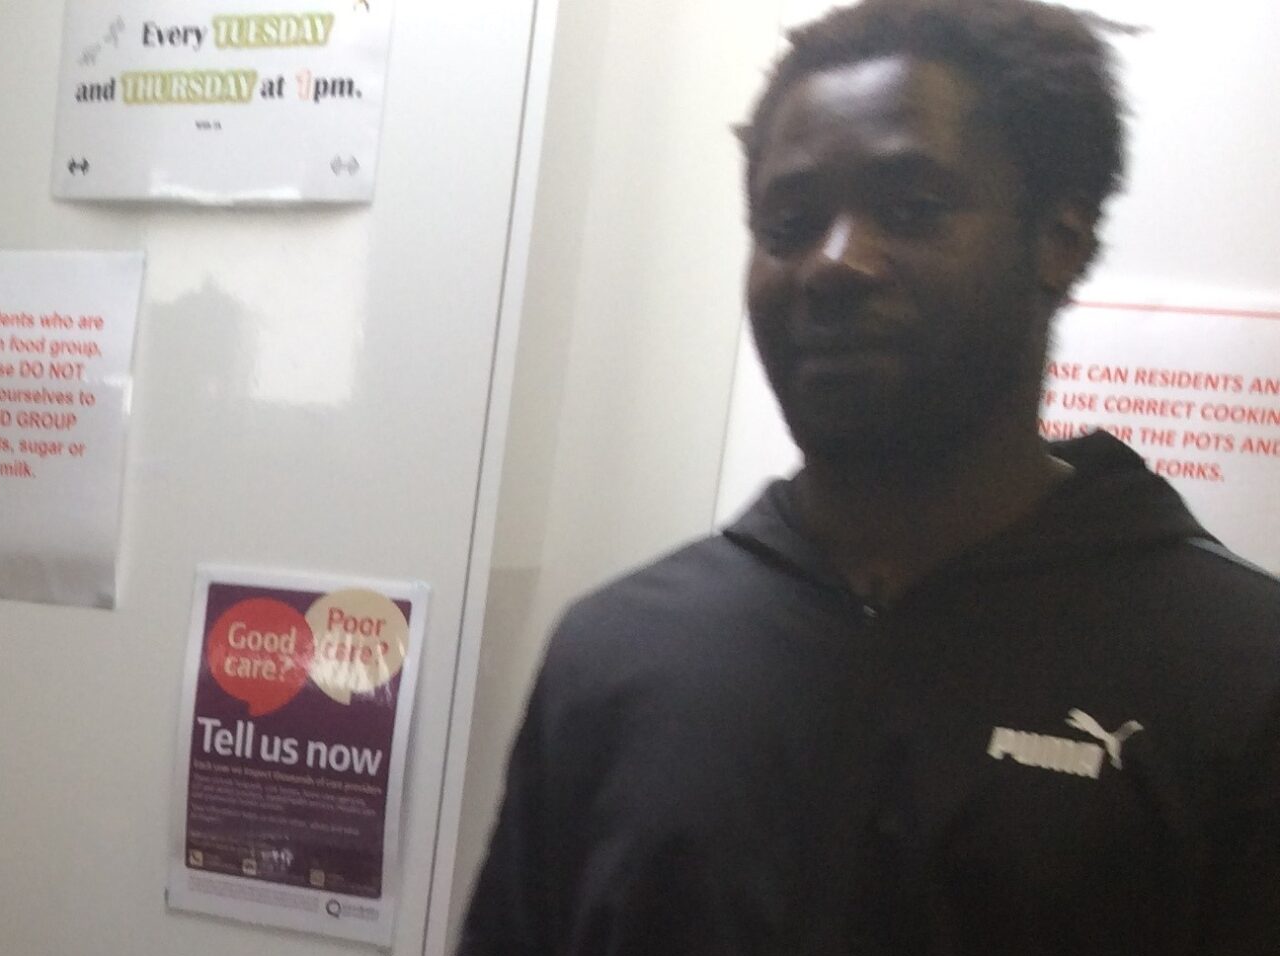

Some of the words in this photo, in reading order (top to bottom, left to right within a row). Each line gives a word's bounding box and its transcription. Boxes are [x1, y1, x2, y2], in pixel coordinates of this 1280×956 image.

[142, 20, 206, 51] Every
[217, 17, 328, 46] TUESDAY
[75, 77, 116, 103] and
[123, 72, 251, 101] THURSDAY
[260, 77, 285, 99] at
[40, 312, 73, 329] who
[78, 315, 104, 330] are
[10, 334, 46, 353] food
[20, 360, 45, 379] DO
[49, 362, 85, 381] NOT
[1046, 361, 1082, 381] ASE
[1087, 364, 1128, 384] CAN
[1134, 367, 1243, 392] RESIDENTS
[1248, 377, 1280, 396] AN
[79, 390, 96, 407] to
[1062, 393, 1097, 412] USE
[1104, 396, 1195, 419] CORRECT
[1200, 403, 1280, 425] COOKIN
[16, 411, 77, 430] GROUP
[19, 440, 63, 458] sugar
[68, 442, 86, 457] or
[1139, 427, 1175, 446] THE
[1182, 431, 1235, 451] POTS
[0, 460, 36, 478] milk.
[327, 607, 386, 636] Poor
[228, 622, 297, 655] Good
[224, 653, 294, 682] care?
[197, 716, 255, 759] Tell
[260, 734, 299, 765] us
[306, 740, 382, 776] now
